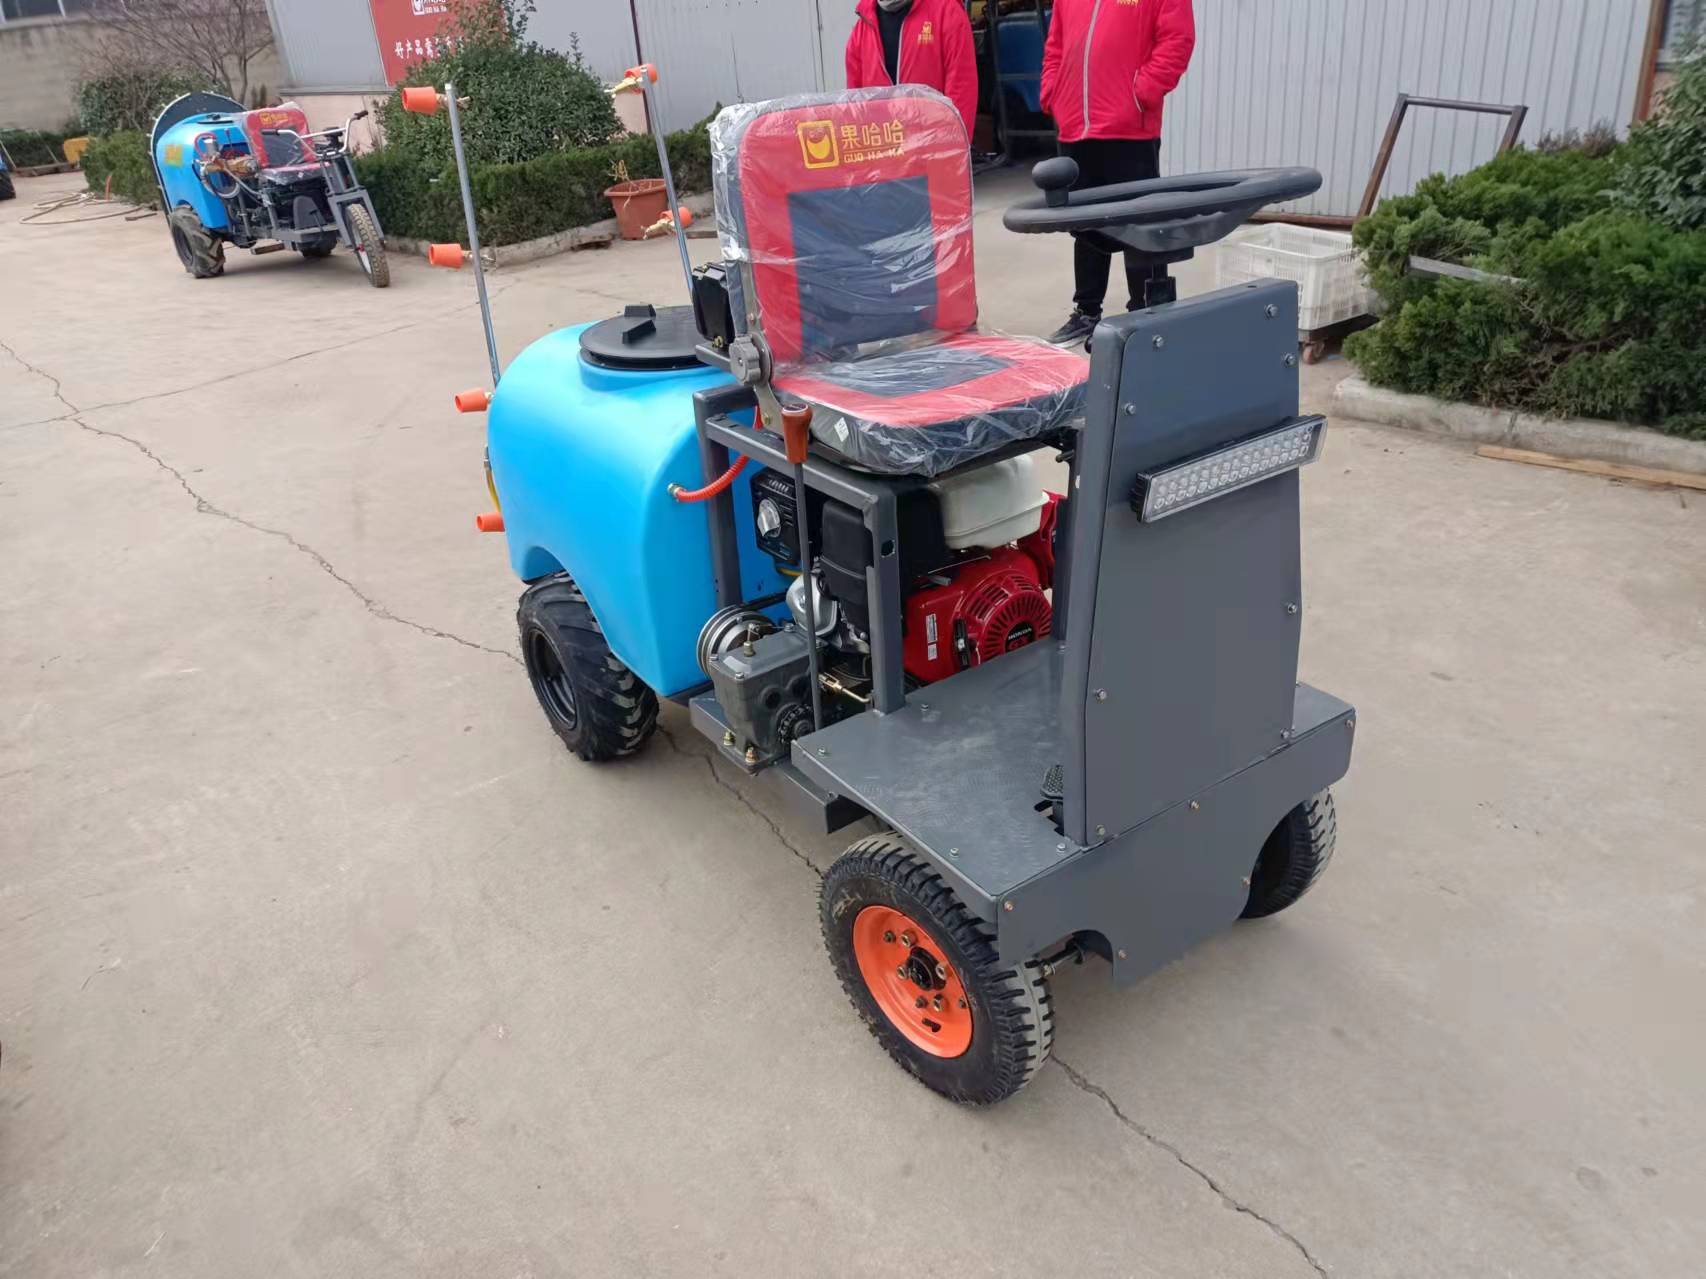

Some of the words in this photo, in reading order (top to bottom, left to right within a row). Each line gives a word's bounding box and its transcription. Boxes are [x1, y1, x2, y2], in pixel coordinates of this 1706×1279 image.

[840, 120, 904, 149] 果哈哈
[843, 152, 864, 163] GUO
